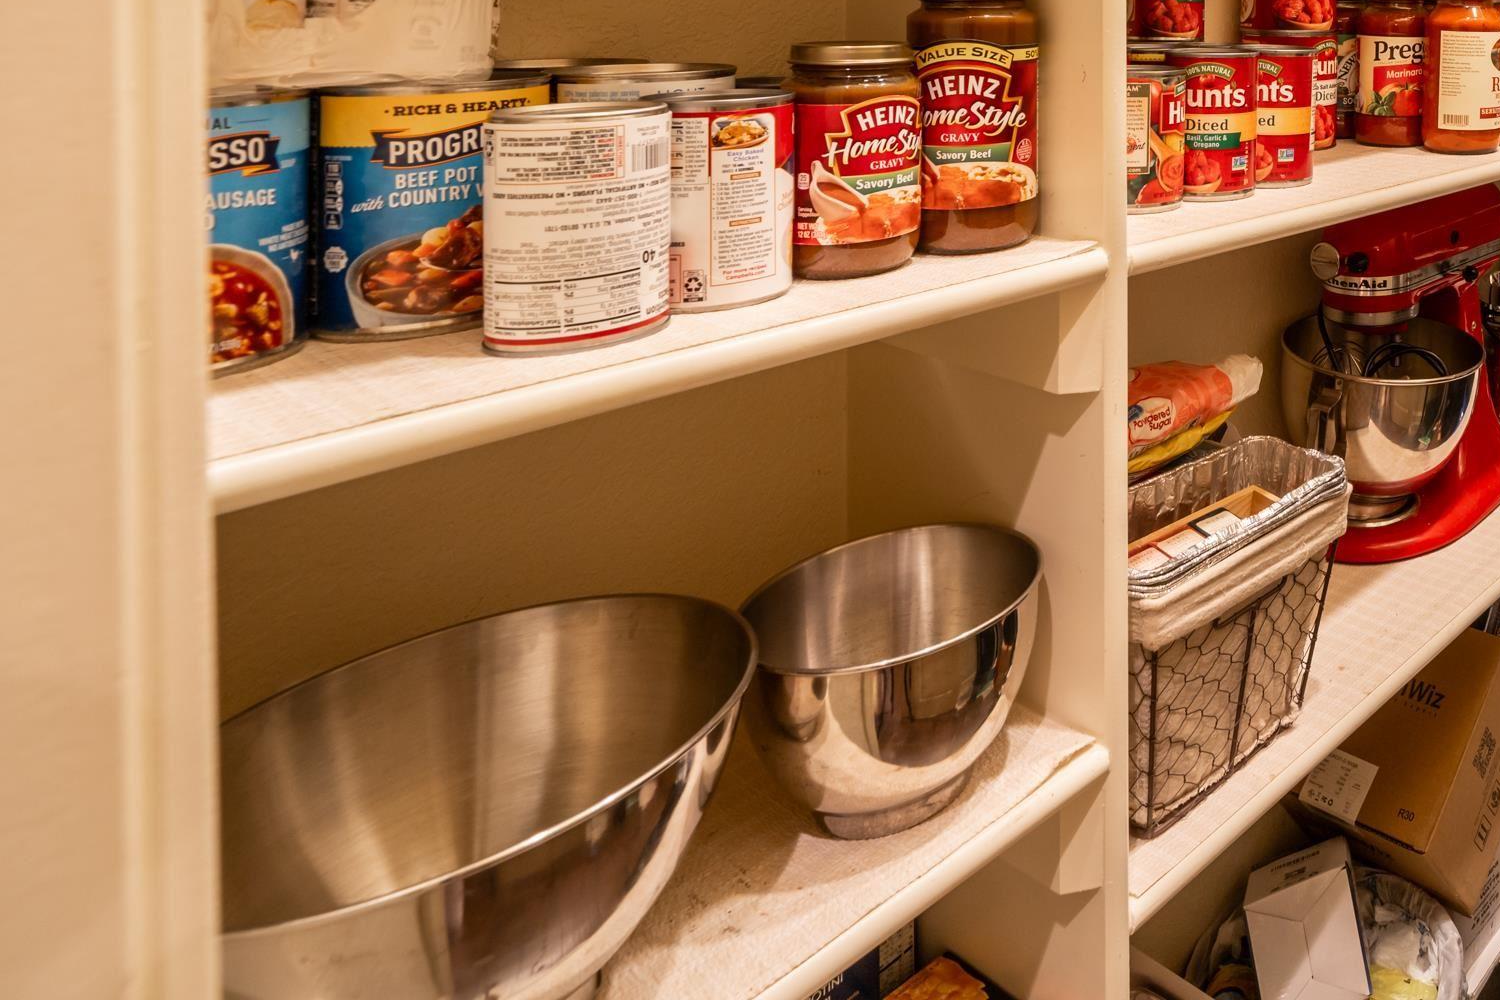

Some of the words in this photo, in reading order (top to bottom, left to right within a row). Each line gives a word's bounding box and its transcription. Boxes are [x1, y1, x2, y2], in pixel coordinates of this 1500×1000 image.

[917, 47, 966, 65] VALUE
[971, 47, 1009, 65] SIZE
[1187, 66, 1201, 76] 100%
[1201, 65, 1232, 78] NATURAL
[1386, 68, 1422, 80] Marinara
[926, 74, 1001, 100] HEINZ
[1315, 91, 1336, 102] Diced
[393, 104, 440, 117] RICH
[446, 103, 457, 114] &
[462, 97, 527, 115] HEARTY
[856, 105, 916, 132] HEINZ
[1186, 118, 1229, 131] Diced
[940, 132, 981, 144] GRAVY
[1193, 141, 1220, 149] Oregano
[936, 150, 966, 162] Savory
[969, 148, 992, 160] Beef
[869, 156, 905, 171] GRAVY
[395, 170, 438, 190] BEEF
[445, 166, 478, 184] POT
[856, 177, 895, 190] Savory
[896, 172, 914, 186] Beef
[351, 197, 385, 213] with
[388, 183, 469, 208] COUNTRY
[642, 250, 656, 263] 40
[1133, 409, 1172, 430] Powdered
[1148, 417, 1172, 432] Sugar
[1396, 808, 1415, 823] R30
